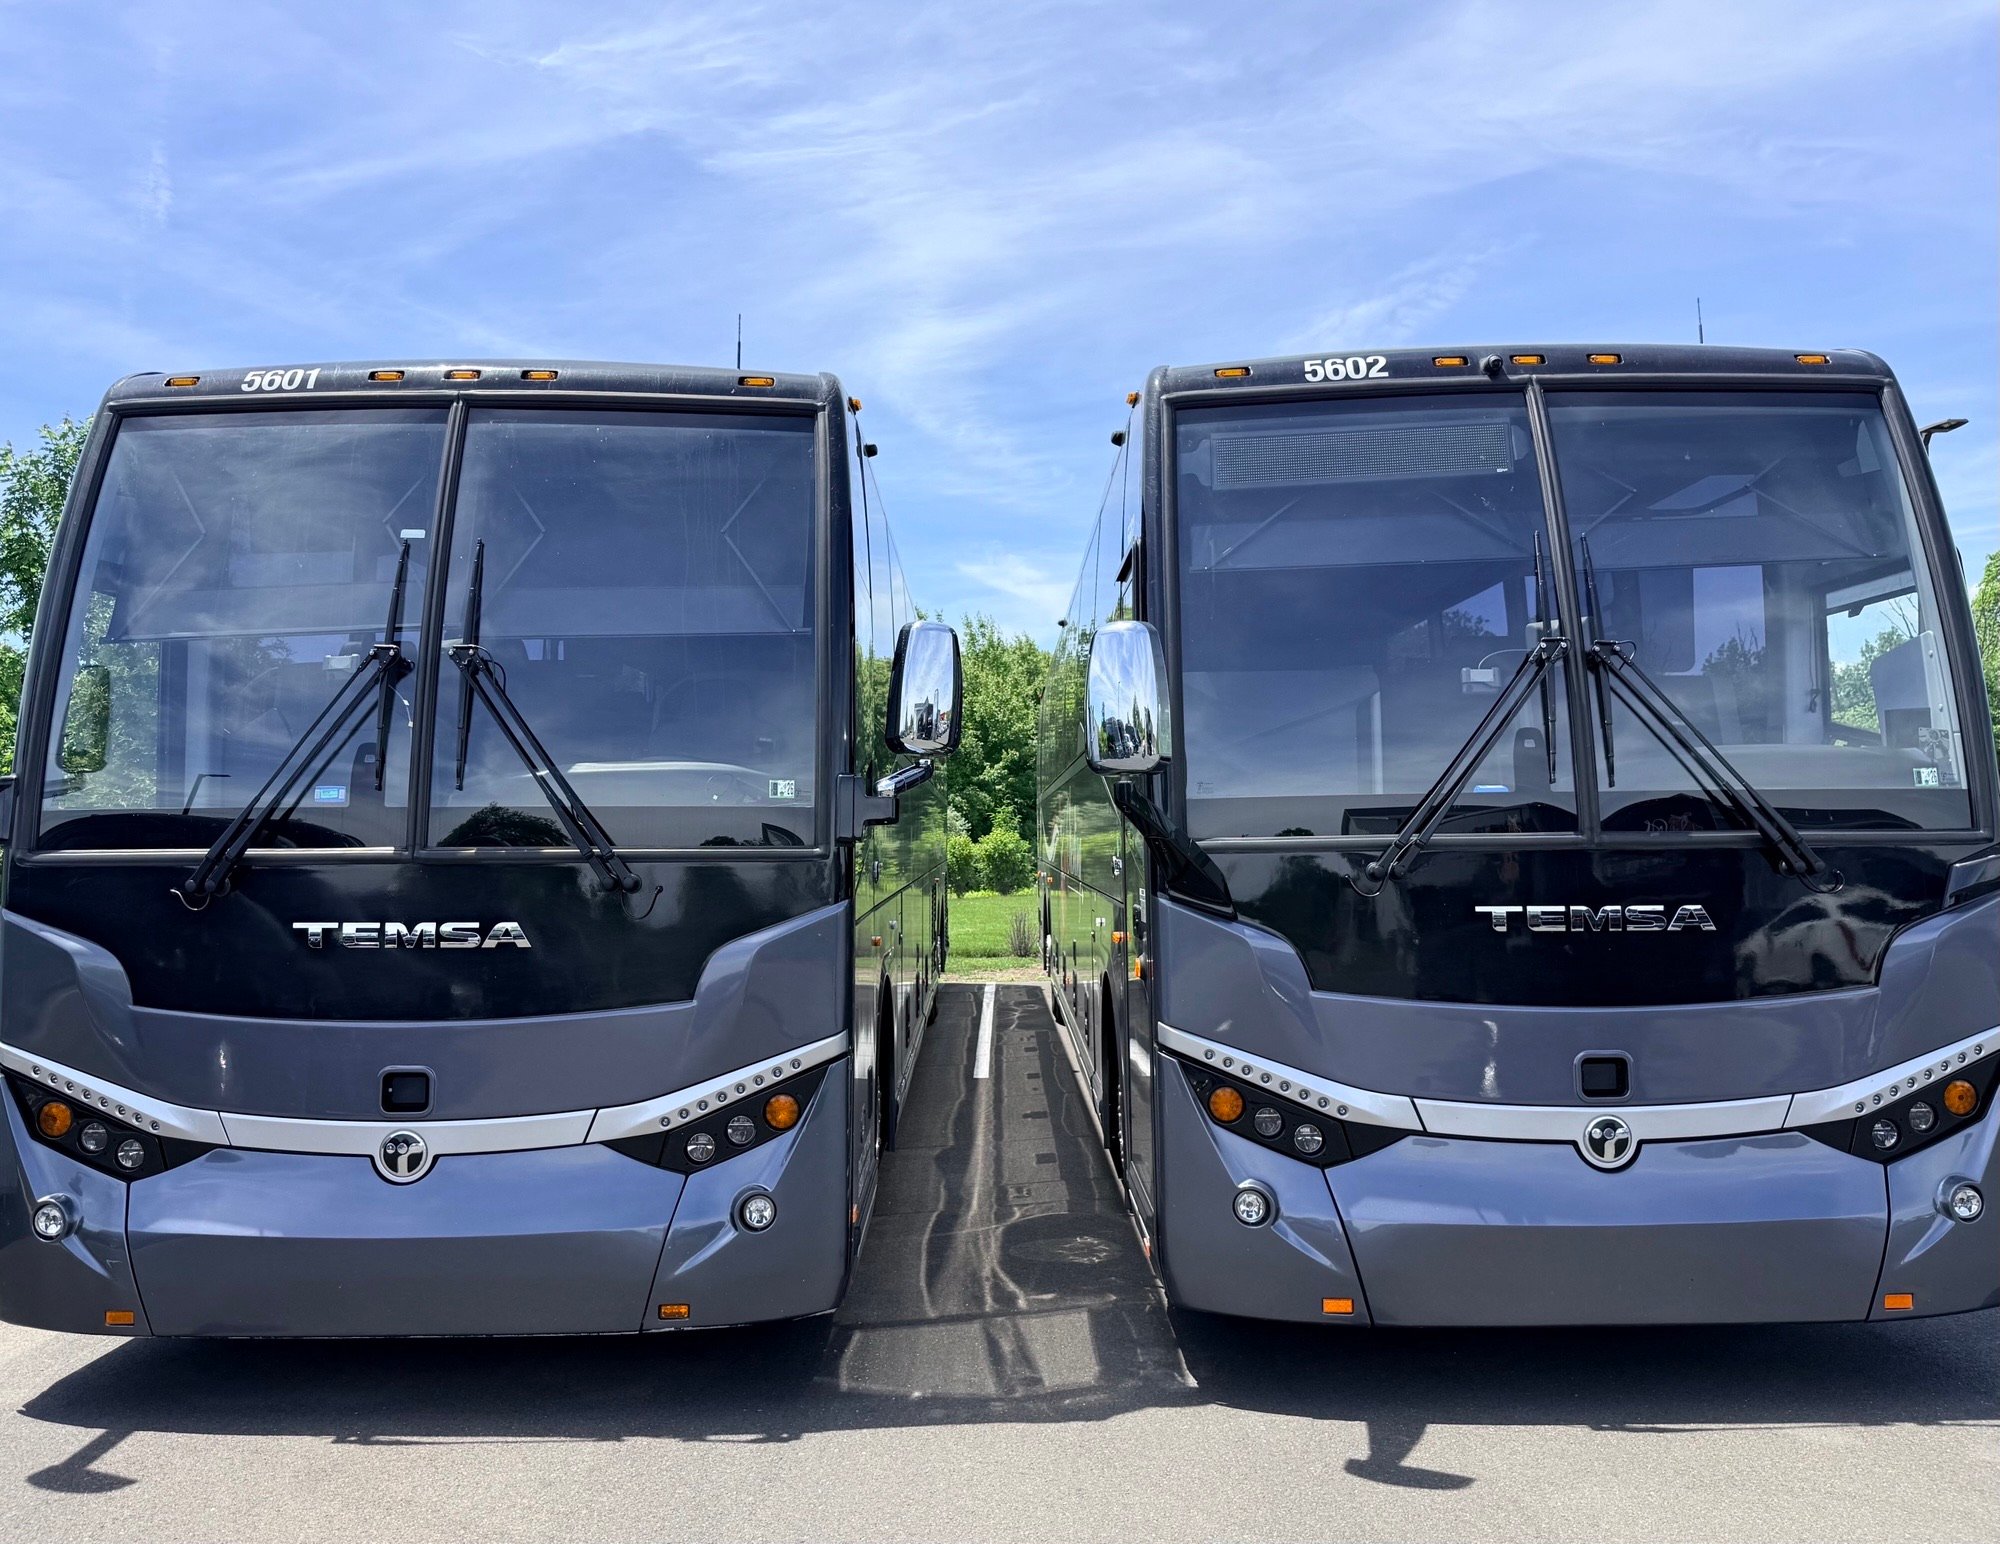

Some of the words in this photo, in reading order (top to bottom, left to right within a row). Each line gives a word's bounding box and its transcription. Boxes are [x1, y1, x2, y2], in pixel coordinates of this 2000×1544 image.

[241, 367, 321, 392] 5601
[1304, 355, 1389, 382] 5602
[1475, 905, 1717, 931] TEMSA
[293, 922, 532, 948] TEMSA
